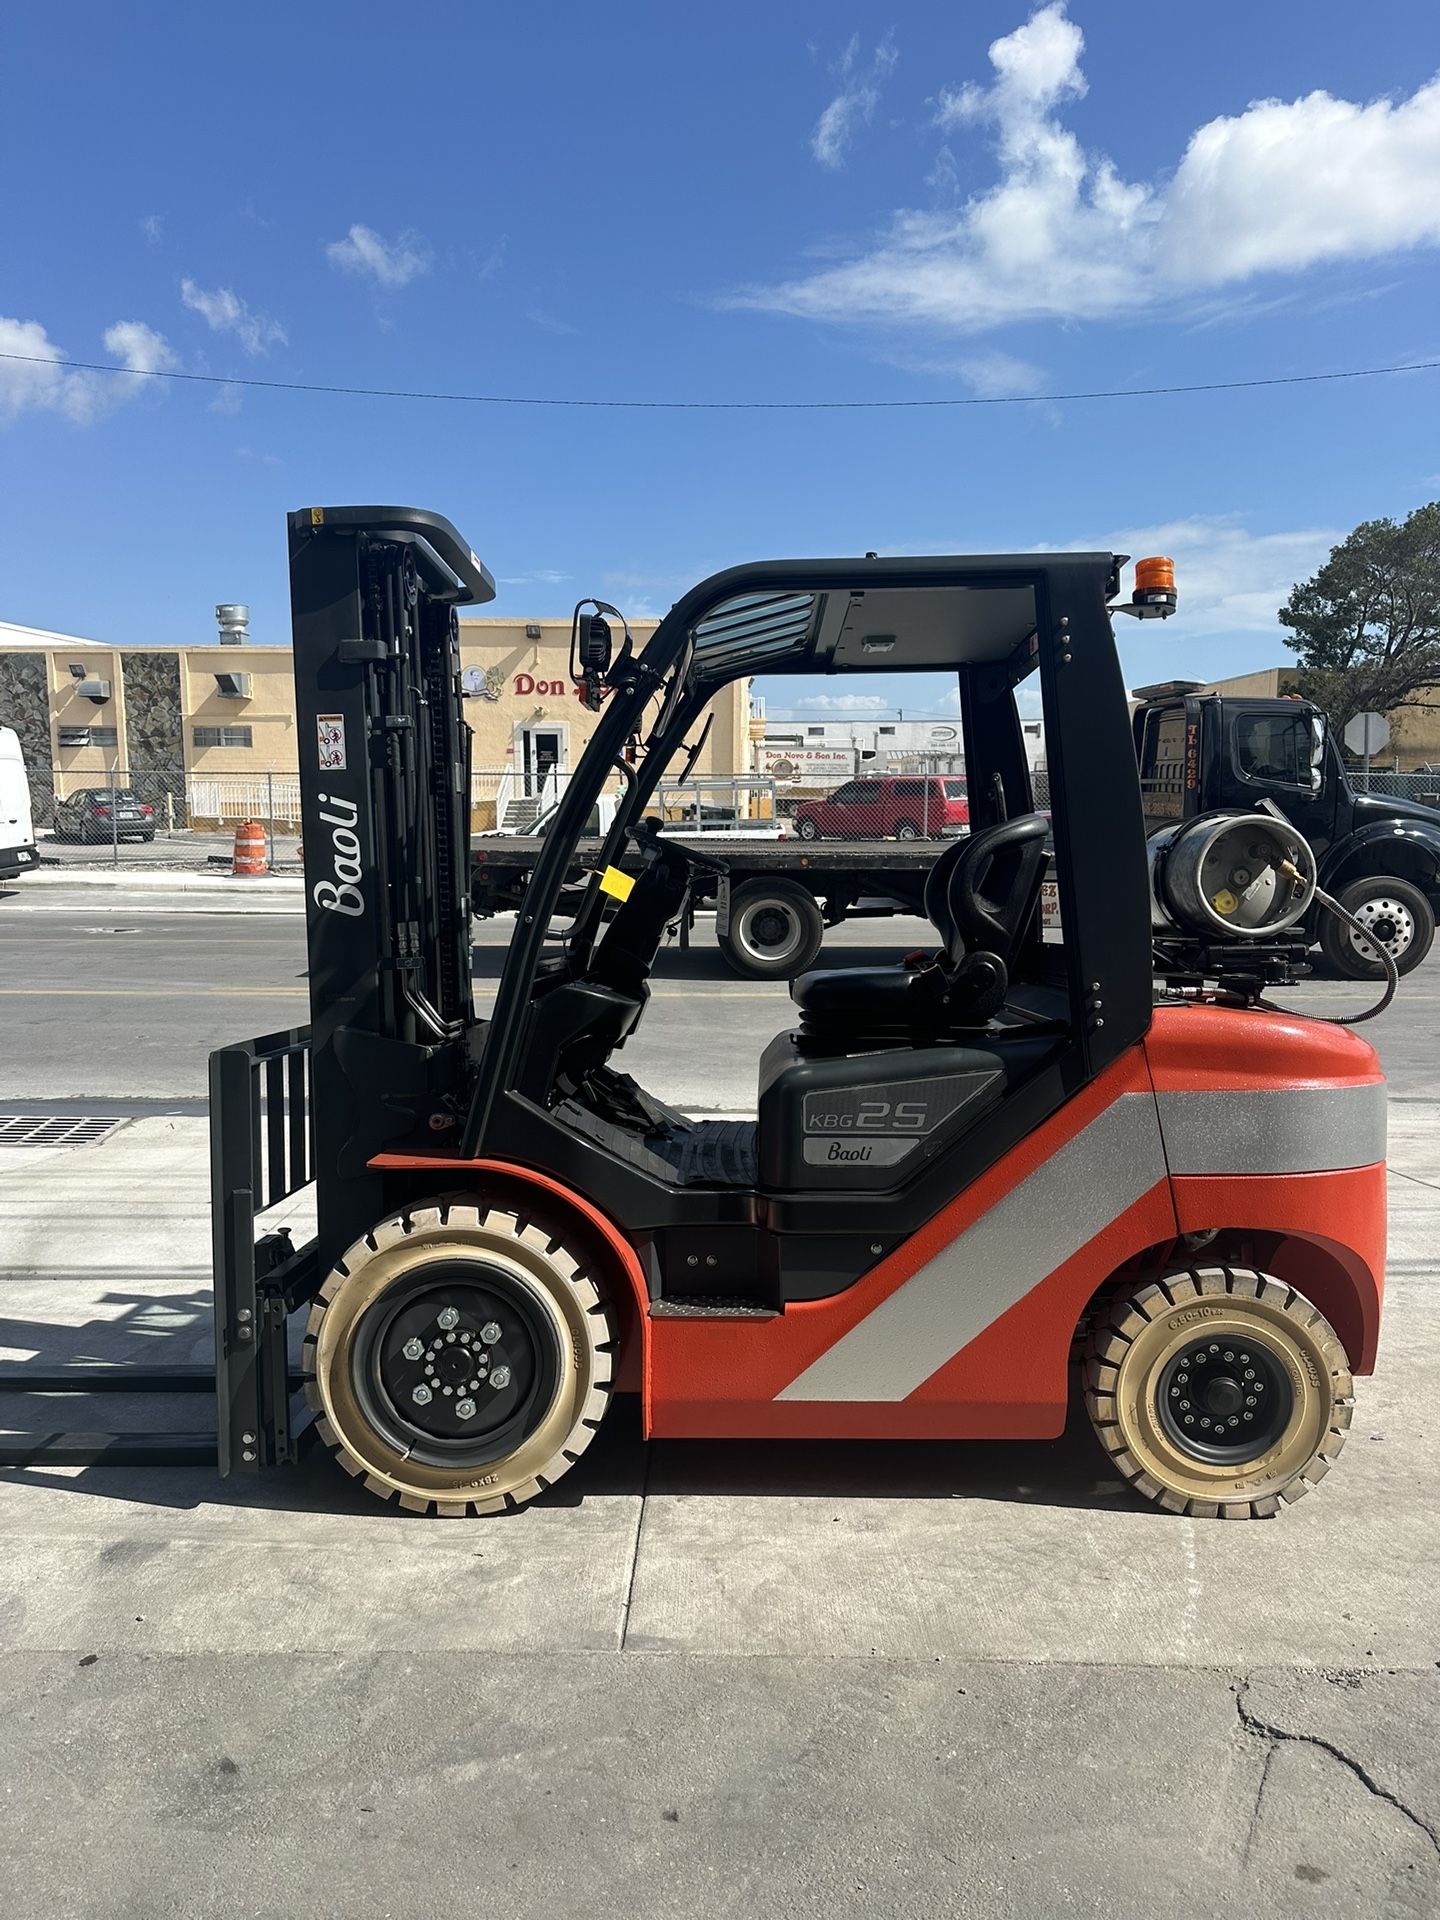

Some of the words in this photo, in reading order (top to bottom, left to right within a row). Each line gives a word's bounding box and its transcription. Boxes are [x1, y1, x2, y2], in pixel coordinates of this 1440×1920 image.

[513, 673, 565, 695] Don
[765, 751, 782, 759] Don
[833, 752, 848, 760] Inc.
[313, 792, 365, 918] Baoli
[1040, 884, 1057, 898] EZ
[827, 1142, 873, 1161] Baoli
